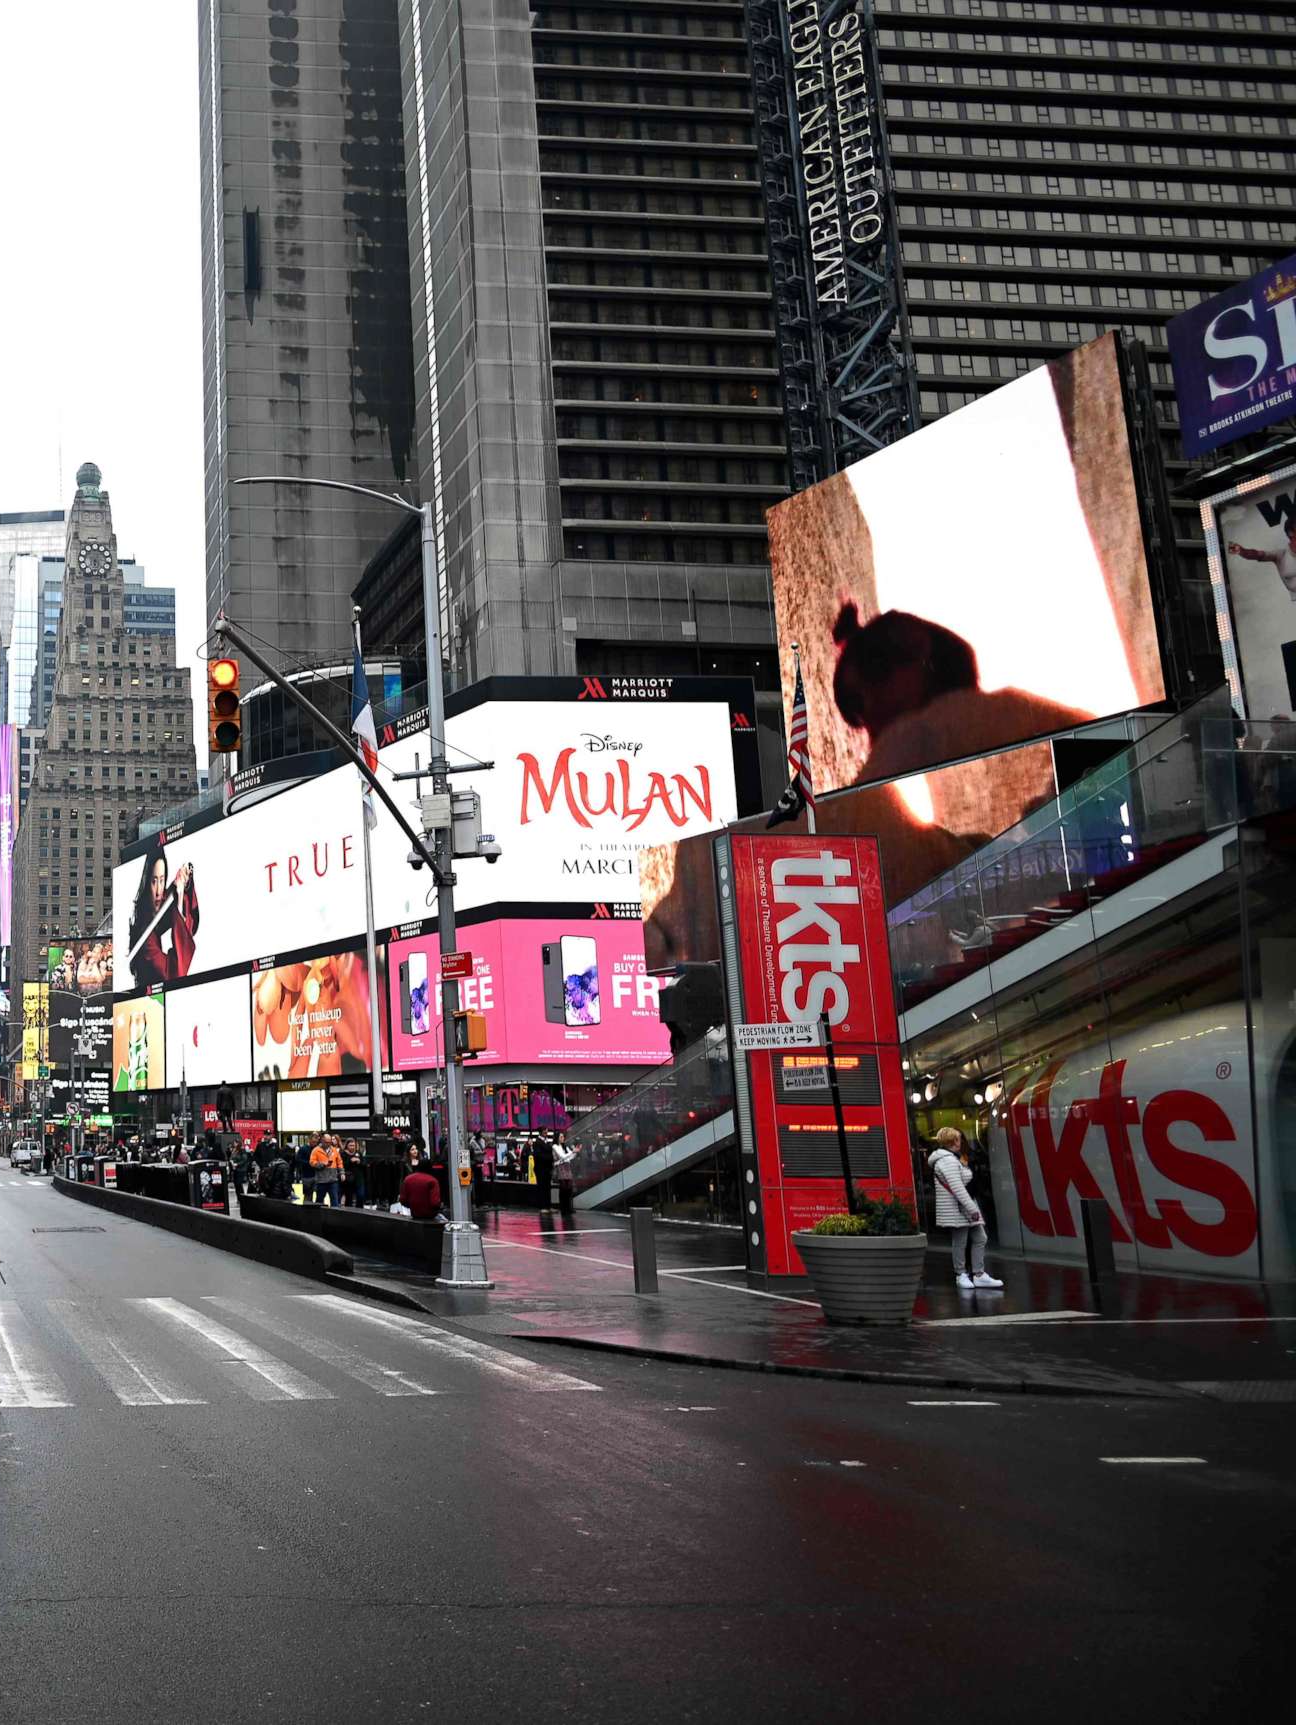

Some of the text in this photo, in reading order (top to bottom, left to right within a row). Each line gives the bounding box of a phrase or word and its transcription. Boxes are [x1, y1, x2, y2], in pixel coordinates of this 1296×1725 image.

[828, 12, 882, 244] OUTFITTERS
[798, 104, 848, 304] AMERICAN
[1247, 376, 1277, 401] THE
[1209, 391, 1293, 434] BROOKS ATKINSON THEATRE
[612, 678, 674, 688] MARRIOTT
[613, 688, 667, 698] MARQUIS
[396, 707, 430, 729] MARRIOTT
[397, 719, 427, 737] MARQUIS
[579, 732, 644, 757] Disney
[233, 765, 265, 783] MARRIOTT
[234, 776, 261, 793] MARQUIS
[264, 835, 354, 893] TRUE
[757, 865, 768, 897] service
[761, 898, 770, 909] of
[400, 920, 423, 932] MARRIOTT
[400, 929, 421, 939] MARQUIS
[762, 909, 772, 942] Theatre
[770, 850, 860, 1026] tkts
[476, 965, 490, 973] ONE
[614, 962, 635, 973] BUY
[764, 944, 777, 1003] Development
[435, 975, 494, 1015] FEE
[309, 1007, 342, 1023] makeup
[311, 1026, 333, 1038] never
[738, 1024, 813, 1036] PEDESTRIAN FLOW ZONE
[294, 1041, 337, 1057] been etter
[739, 1036, 781, 1046] KEEP MOVING
[998, 1059, 1257, 1257] tkts
